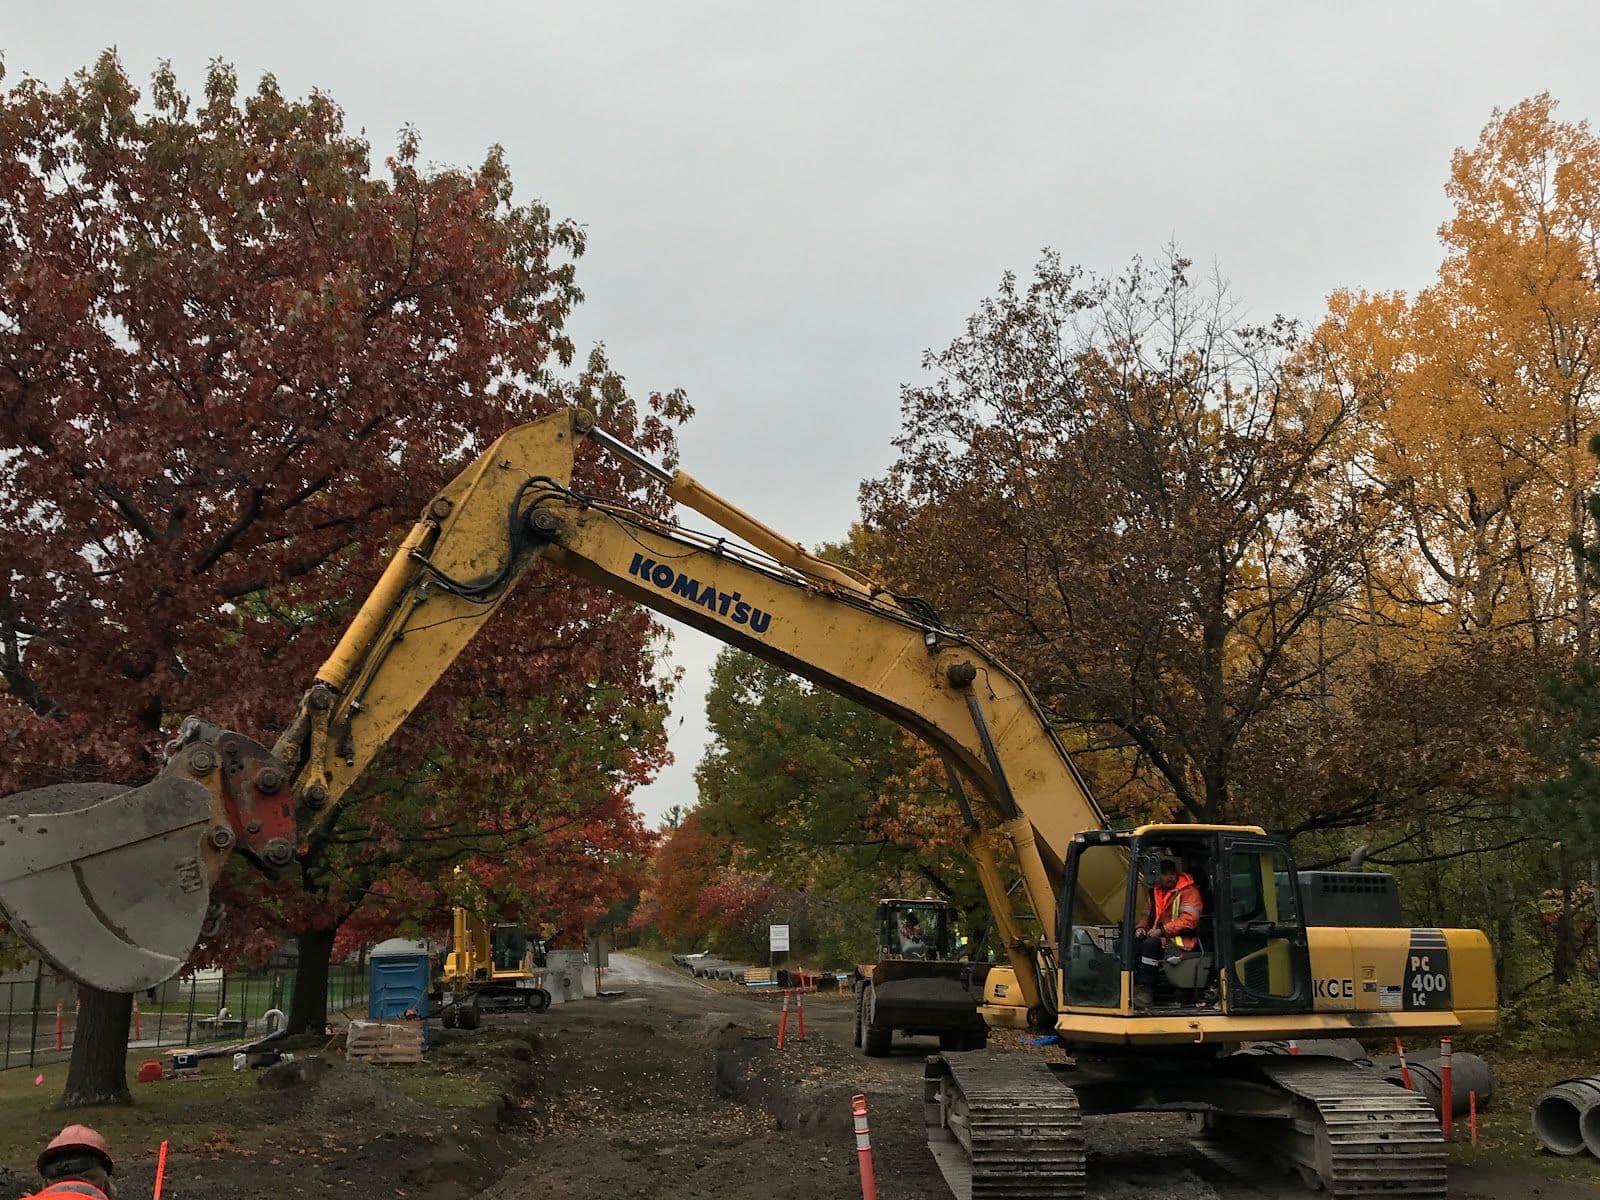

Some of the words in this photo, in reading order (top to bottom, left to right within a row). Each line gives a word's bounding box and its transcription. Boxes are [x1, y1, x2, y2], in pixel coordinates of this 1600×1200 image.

[629, 553, 772, 633] KOMATSU
[1411, 956, 1429, 971] PC
[1313, 979, 1352, 998] KCE
[1411, 974, 1446, 991] 400
[1412, 993, 1426, 1006] LC
